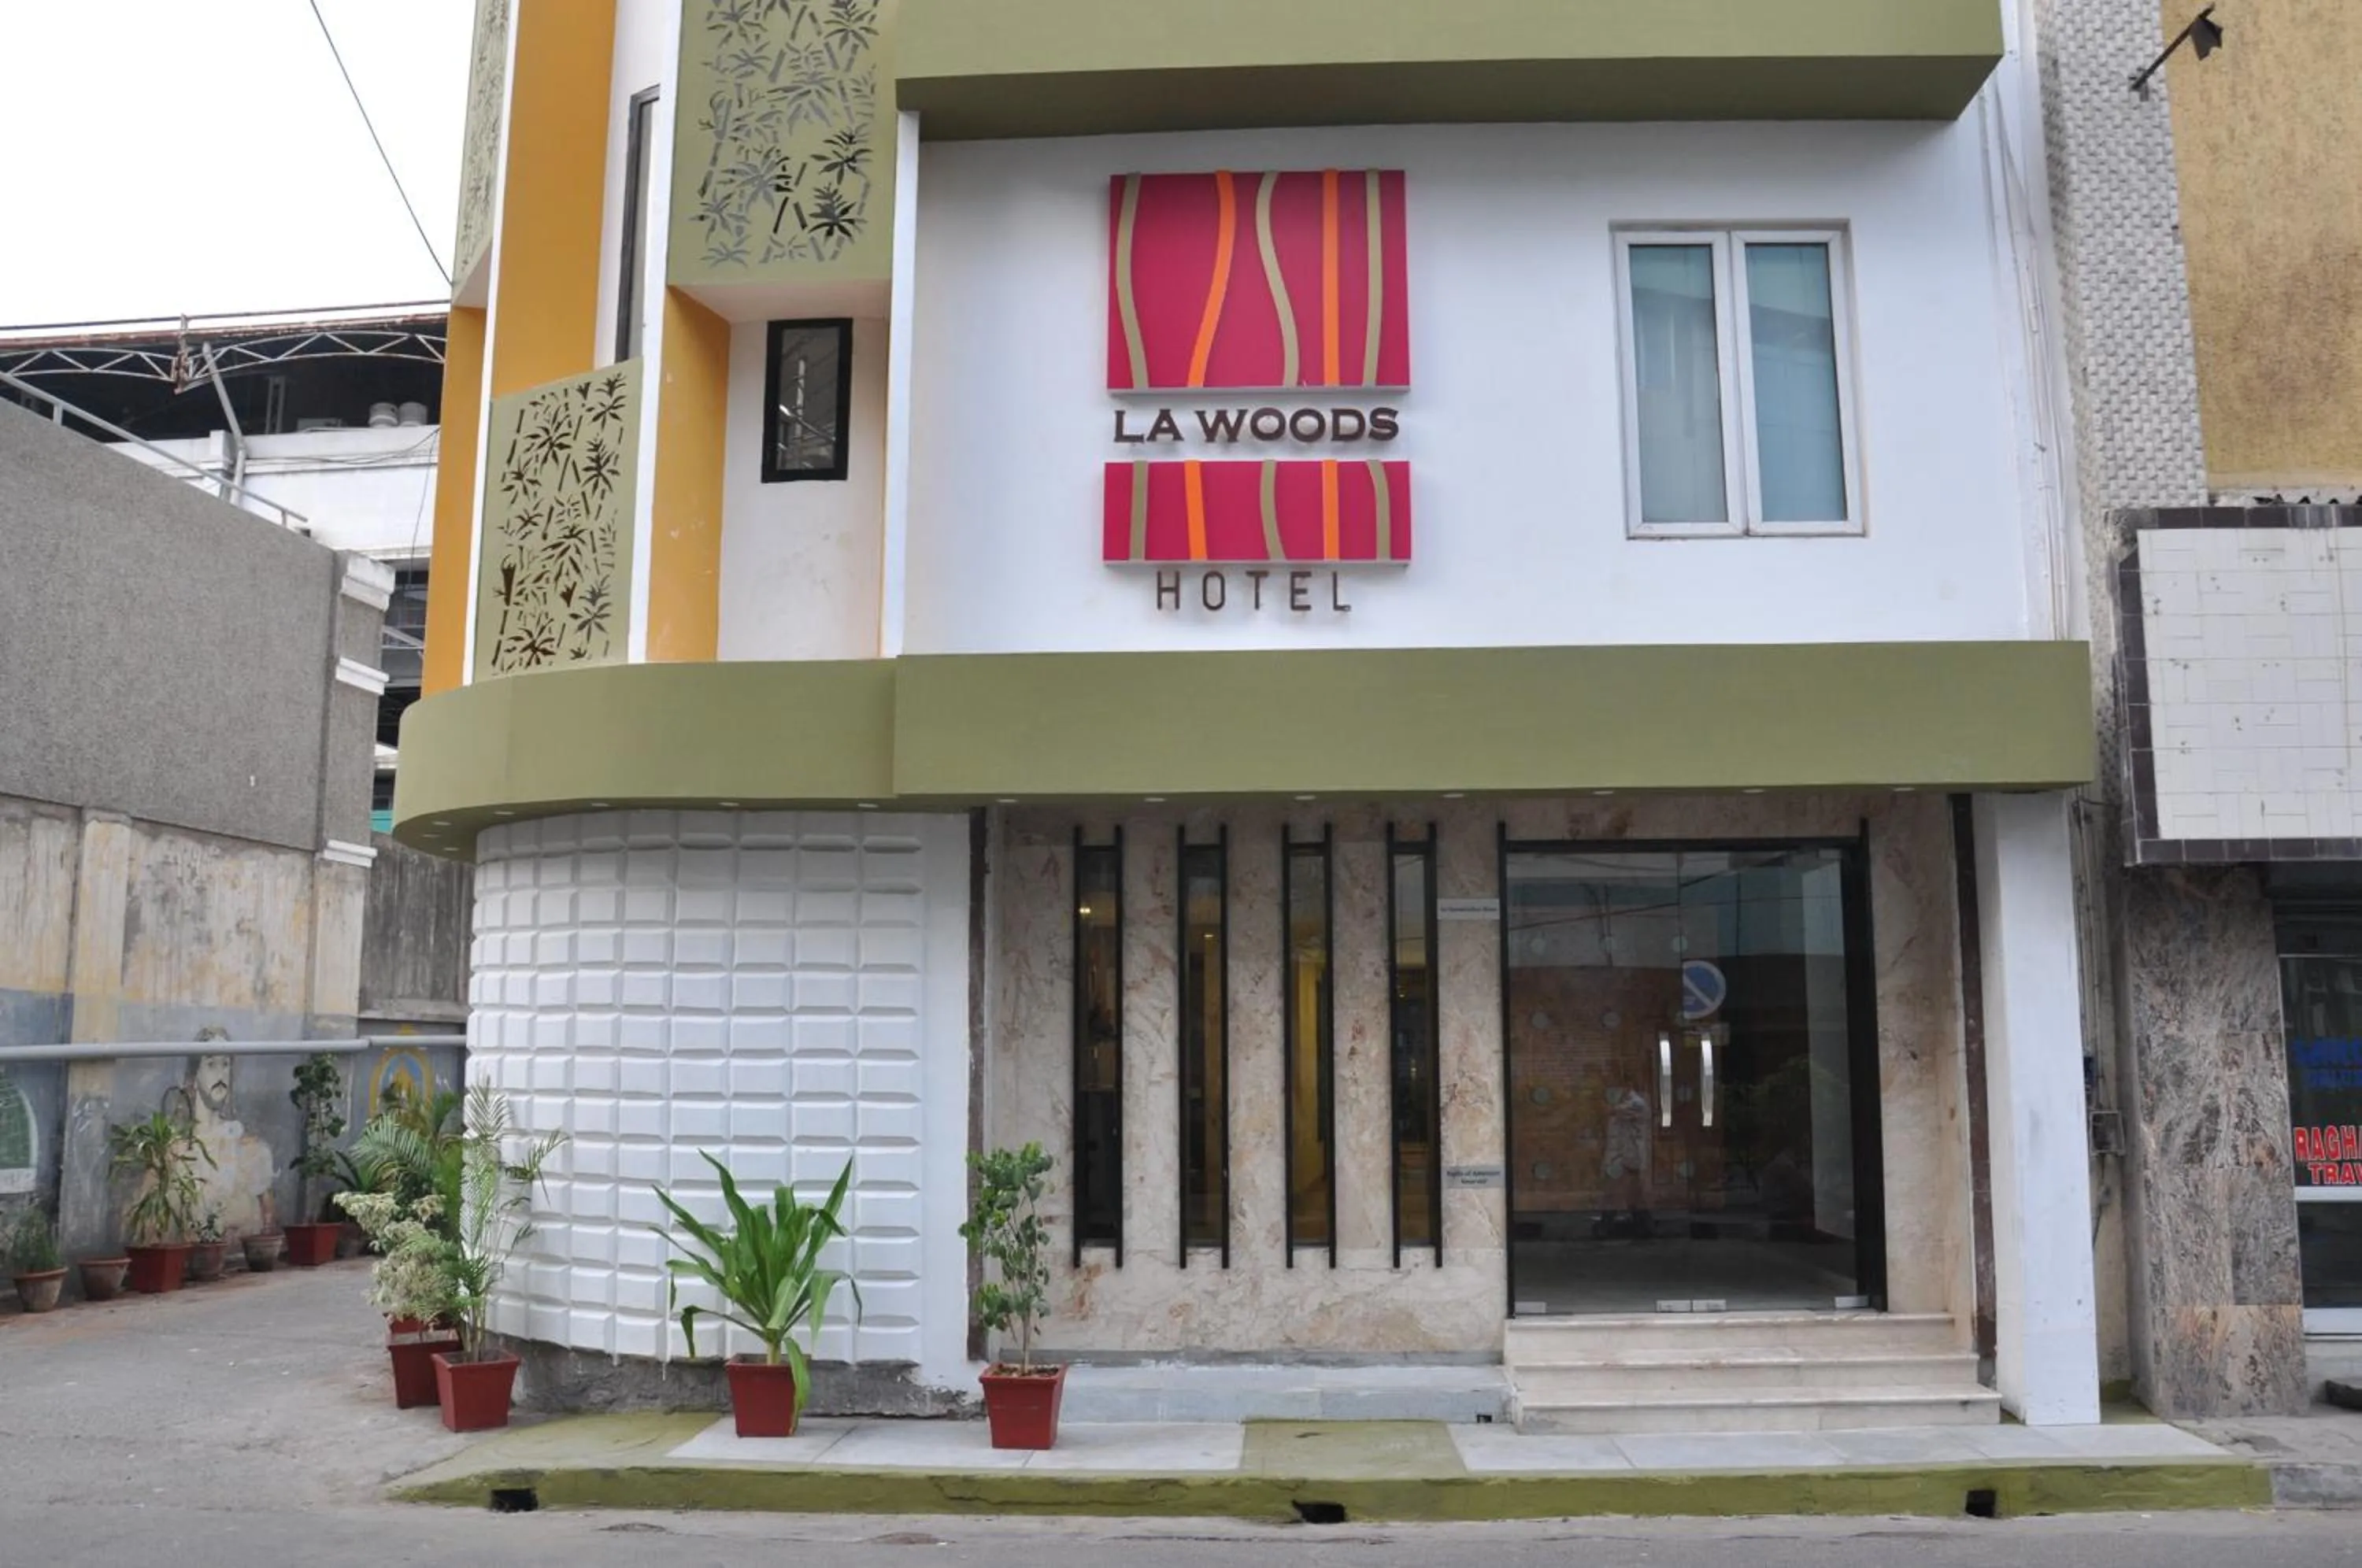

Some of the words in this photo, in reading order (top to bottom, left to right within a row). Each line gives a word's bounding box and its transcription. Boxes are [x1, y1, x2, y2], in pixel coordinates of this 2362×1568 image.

[1114, 409, 1183, 443] LA
[1196, 407, 1399, 443] WOODS
[1156, 570, 1352, 612] HOTEL
[2294, 1125, 2362, 1161] RAGH
